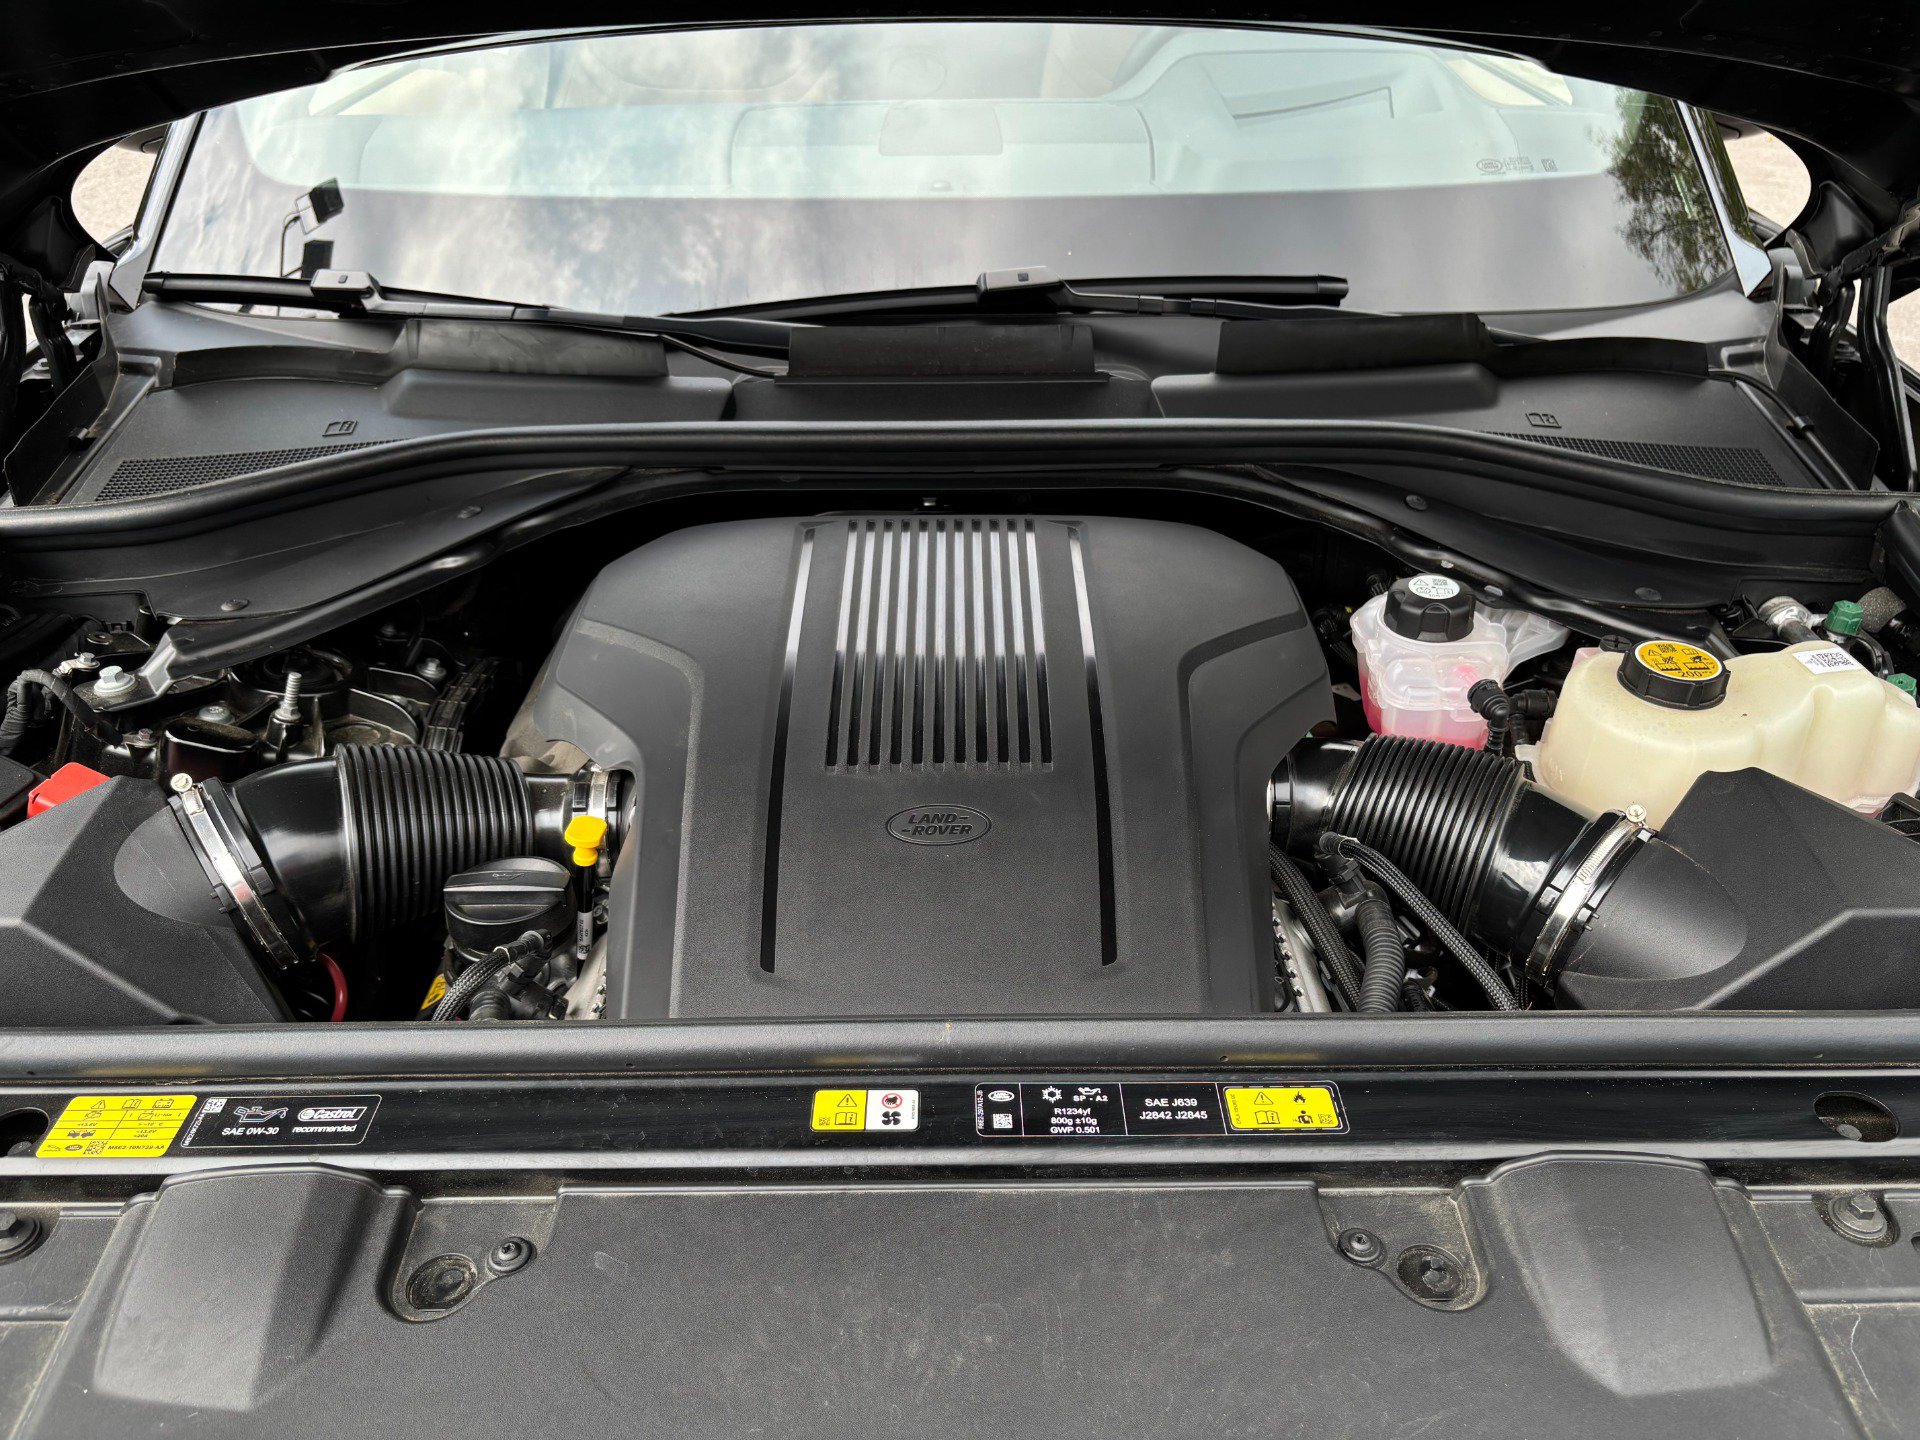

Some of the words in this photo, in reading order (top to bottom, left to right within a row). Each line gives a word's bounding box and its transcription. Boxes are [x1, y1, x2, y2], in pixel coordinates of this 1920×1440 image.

[908, 813, 958, 824] LAND
[911, 824, 973, 836] ROVER
[1144, 1098, 1170, 1107] SAE
[1171, 1098, 1198, 1107] J639
[313, 1108, 358, 1119] Castrol
[1054, 1107, 1092, 1116] R1234yf
[1139, 1111, 1172, 1120] J2842
[1175, 1110, 1208, 1119] J2845
[1050, 1117, 1074, 1125] 800g
[1075, 1117, 1098, 1126] ±10g
[222, 1127, 244, 1136] SAE
[246, 1126, 279, 1135] 0W-30
[291, 1124, 357, 1133] recommended
[1050, 1126, 1074, 1134] GWP
[1075, 1126, 1100, 1134] 0.501
